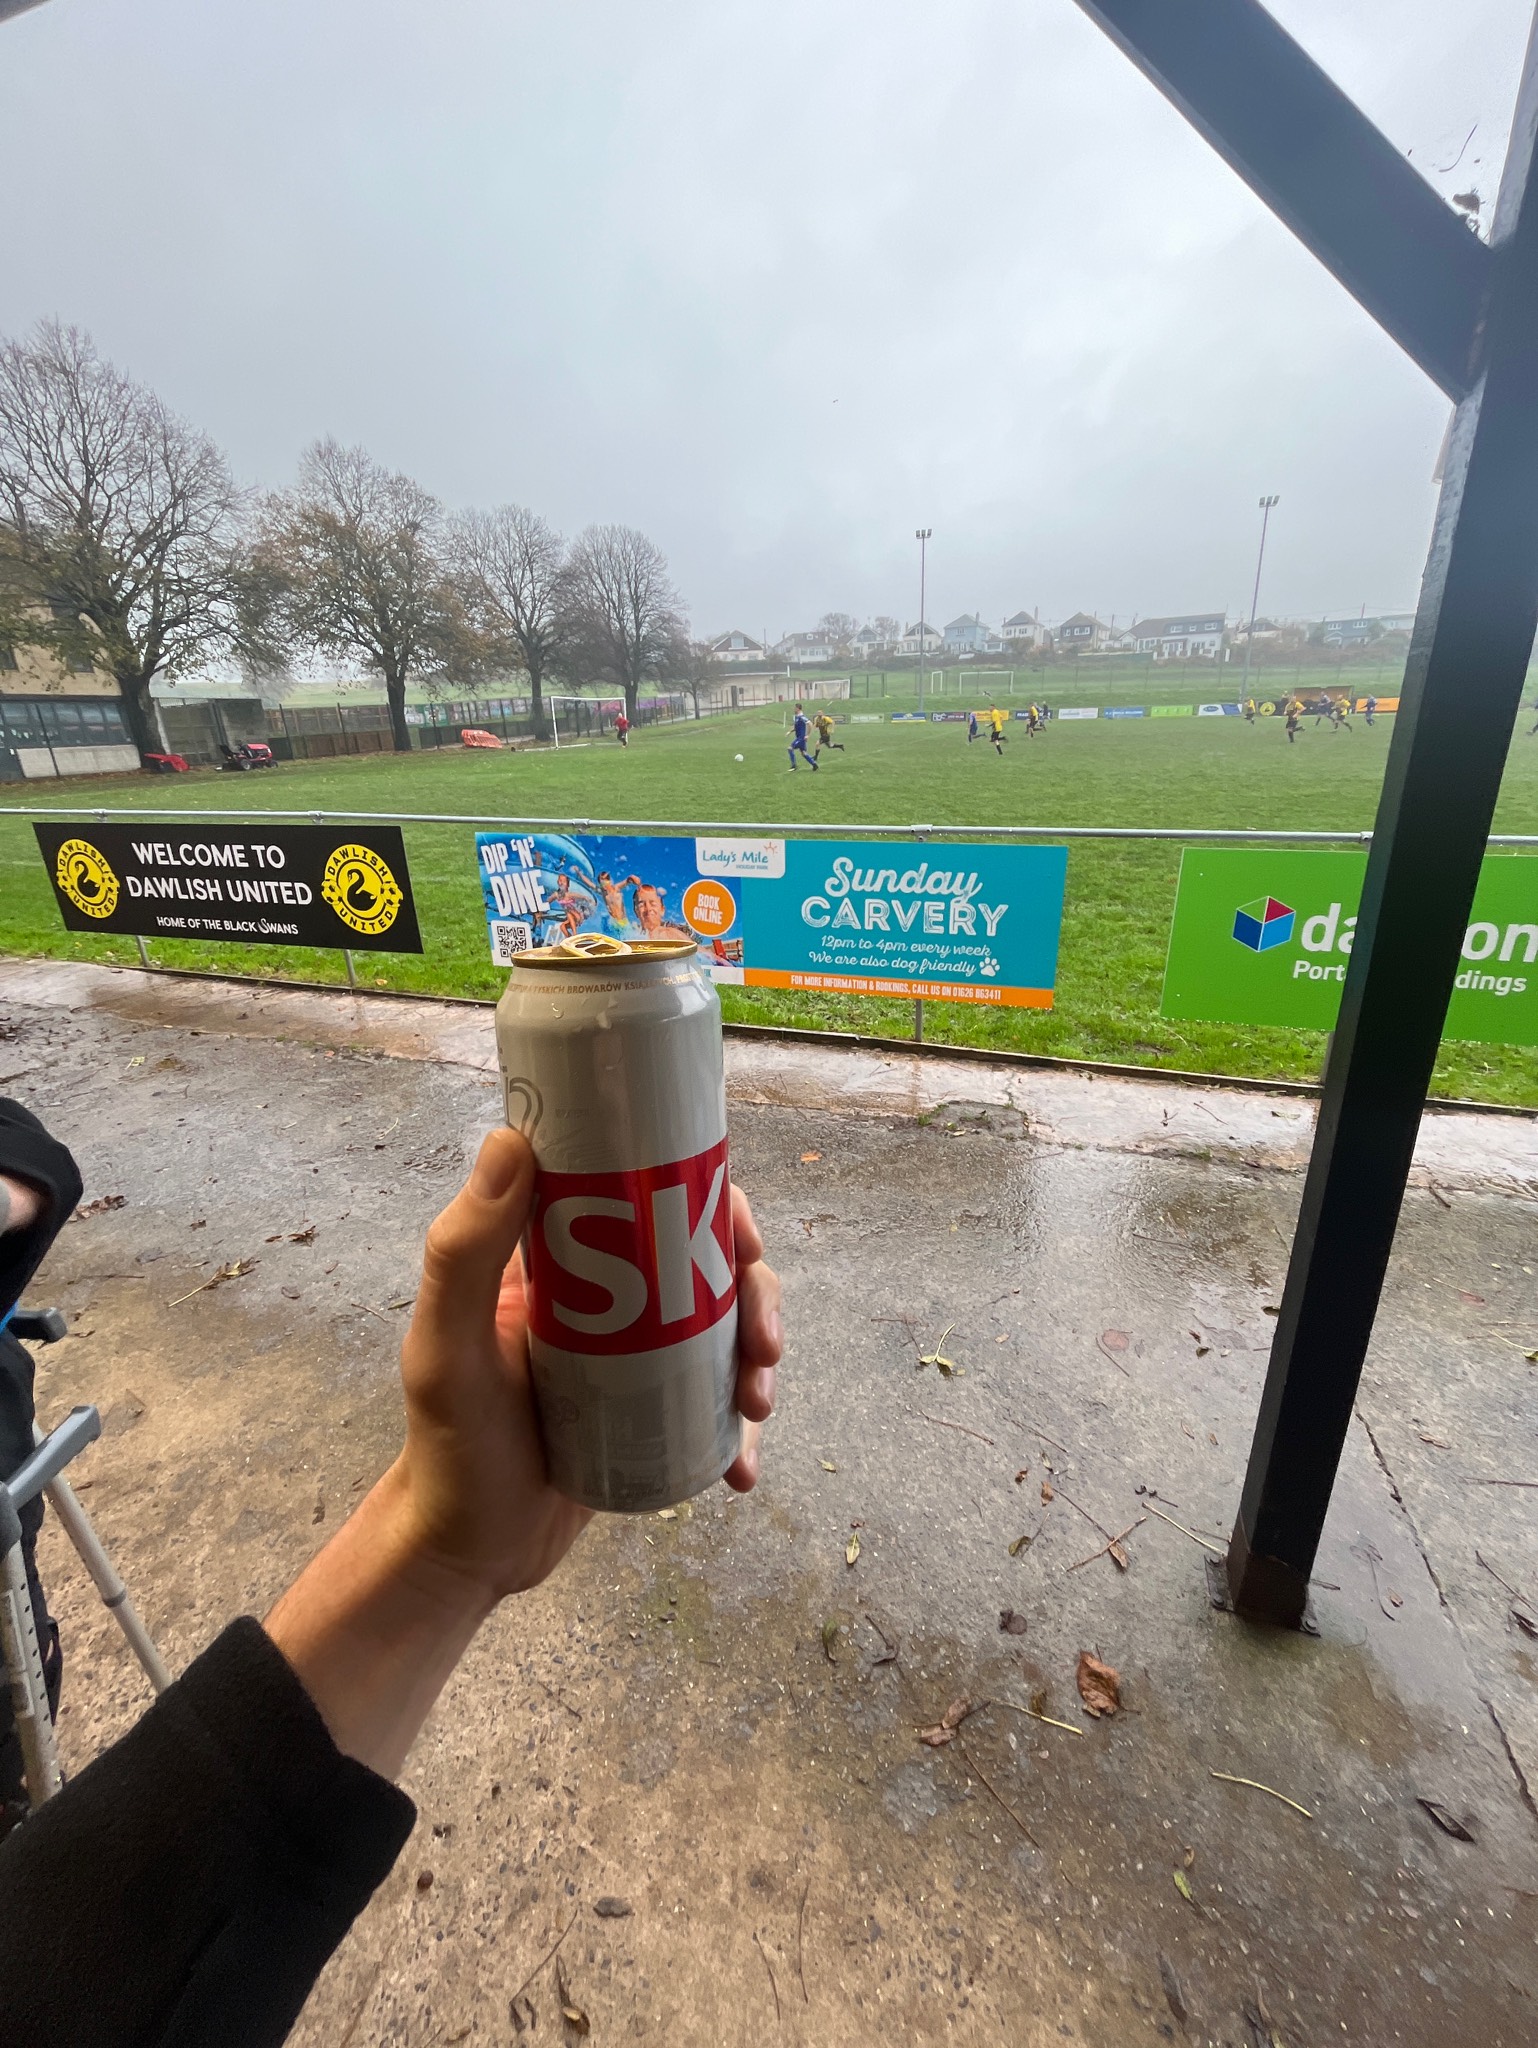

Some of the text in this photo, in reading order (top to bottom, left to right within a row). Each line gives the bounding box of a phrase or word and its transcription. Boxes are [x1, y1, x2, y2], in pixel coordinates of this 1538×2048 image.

[60, 842, 106, 868] DAWLISH
[131, 842, 286, 869] WELCOME TO
[327, 847, 388, 876] DAWLISH
[480, 842, 508, 874] DIP
[702, 849, 769, 868] Lady's Mile
[125, 876, 313, 905] DAWLISH UNITED
[489, 869, 550, 916] DINE
[824, 856, 983, 903] Sunday
[73, 895, 115, 916] UNITED
[697, 893, 721, 910] BOOK
[156, 916, 299, 935] HOME OF THE BLACK SWANS
[339, 908, 393, 931] UNITED
[693, 906, 723, 925] ONLINE
[801, 896, 1009, 937] CARVERY
[821, 935, 992, 958] 12pm to 4pm every week
[808, 950, 977, 977] We are also dog friendly
[567, 980, 622, 994] BROWARÓW
[790, 974, 803, 985] FOR
[804, 975, 823, 987] MORE
[823, 977, 868, 990] INFORMATION
[869, 980, 874, 990] &
[876, 981, 910, 994] BOOKINGS,
[912, 983, 930, 995] CALL
[930, 984, 941, 995] US
[941, 985, 952, 996] ON
[952, 986, 974, 998] 01626
[543, 1161, 734, 1335] SK
